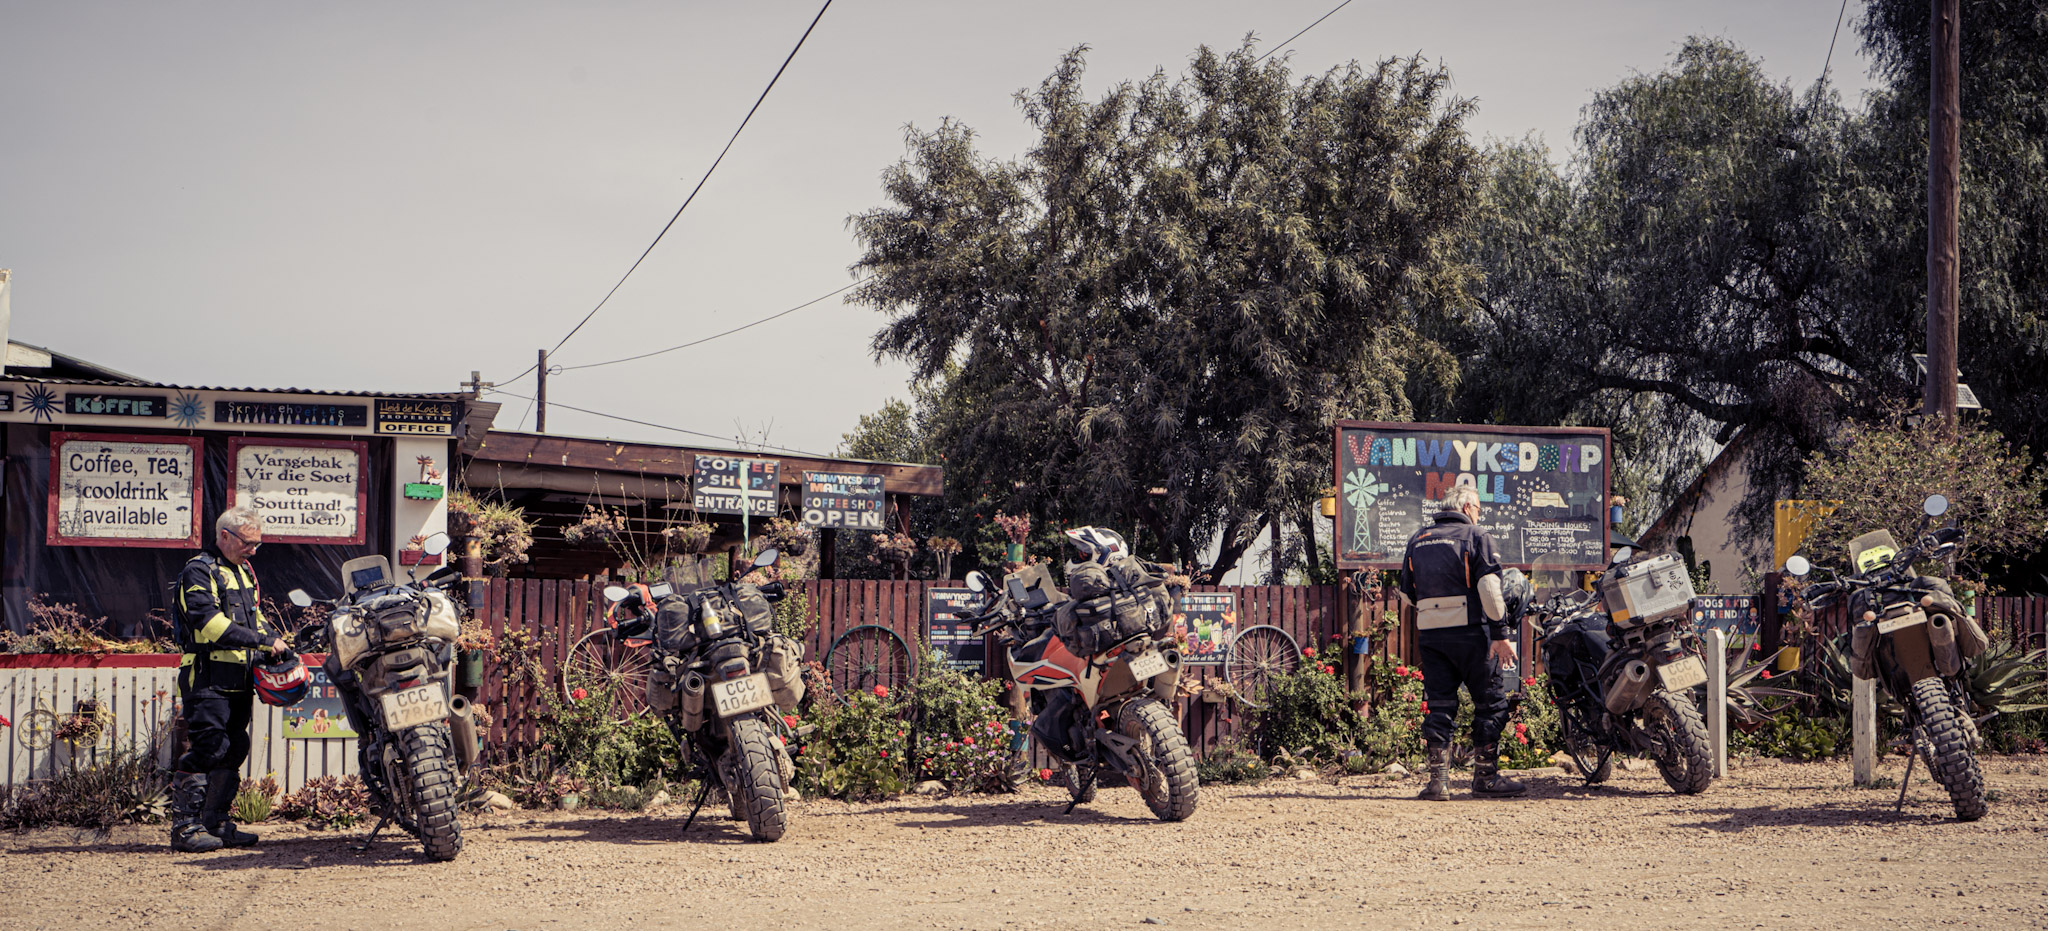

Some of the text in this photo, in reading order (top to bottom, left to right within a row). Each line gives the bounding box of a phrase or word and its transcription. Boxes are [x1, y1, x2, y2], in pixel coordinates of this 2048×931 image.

[402, 403, 412, 412] de
[385, 424, 446, 432] OFFICE
[1348, 434, 1603, 472] VANWYKSDORP
[70, 453, 183, 478] Coffee, Tea,
[254, 453, 343, 469] Varsgebak
[244, 468, 352, 483] Vir die Soet
[805, 473, 881, 485] VANWYKSDORP
[83, 480, 168, 500] cooldrink
[286, 487, 308, 496] en
[809, 482, 848, 494] MALL
[253, 497, 341, 511] Souttand!
[695, 495, 776, 512] ENTRANCE
[805, 497, 882, 510] COFFEE SHOP
[83, 506, 168, 525] available
[262, 515, 295, 524] om
[301, 513, 346, 527] loer!)
[804, 509, 880, 527] OPEN
[1698, 598, 1723, 608] DOGS
[1733, 599, 1755, 608] KIDS
[1705, 609, 1748, 619] FRIENDLY
[1138, 657, 1156, 669] CCC
[1667, 660, 1692, 675] CCC
[1670, 670, 1700, 688] 9806
[726, 679, 755, 695] CCC
[396, 688, 430, 707] CCC
[390, 701, 443, 725] 17867
